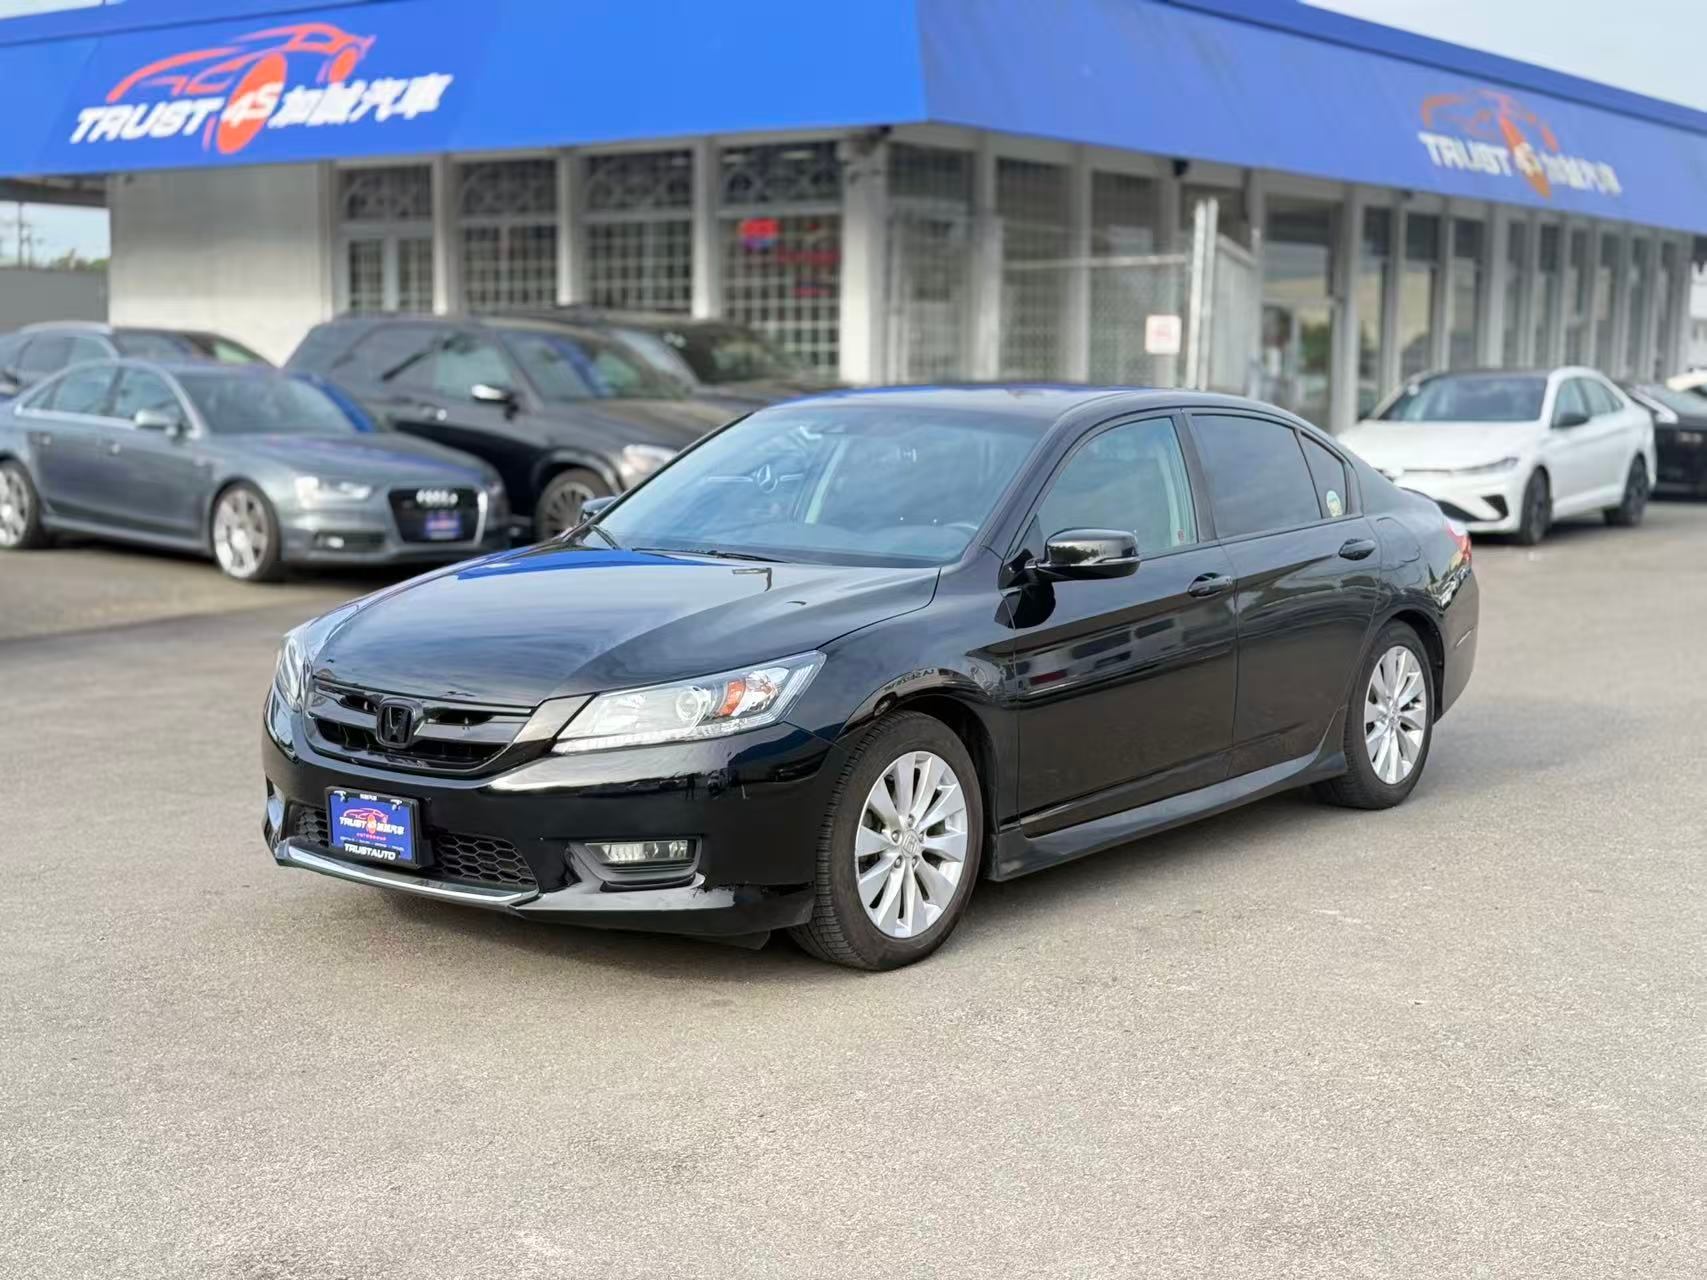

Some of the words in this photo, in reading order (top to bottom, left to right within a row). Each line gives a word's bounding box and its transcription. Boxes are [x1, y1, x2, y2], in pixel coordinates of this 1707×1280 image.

[70, 97, 224, 144] TRUST
[1417, 131, 1512, 177] TRUST
[344, 843, 396, 861] TRUSTAUTO
